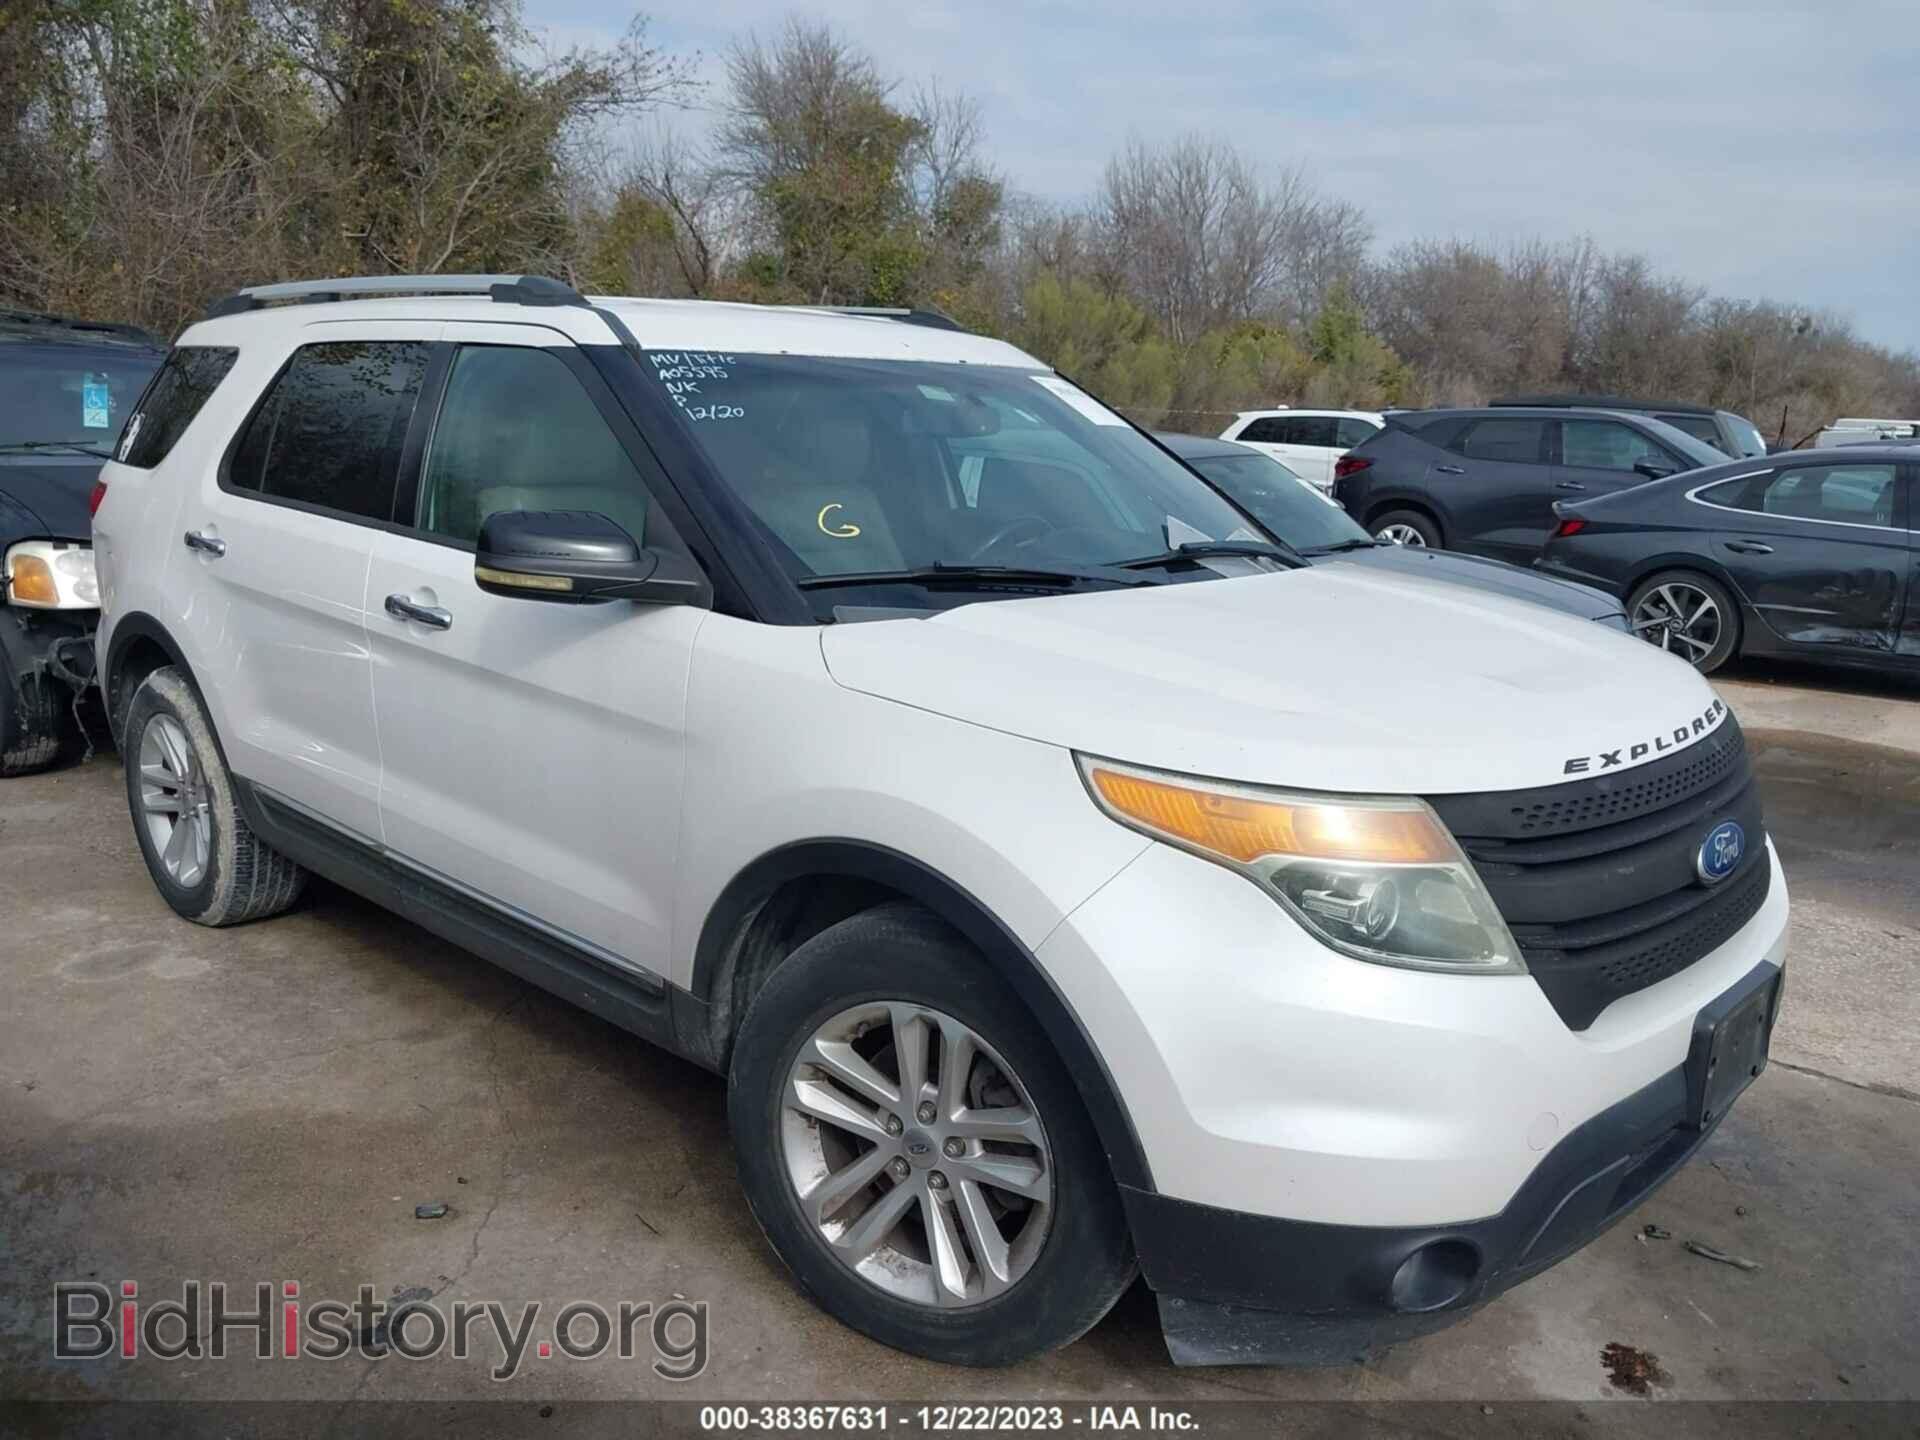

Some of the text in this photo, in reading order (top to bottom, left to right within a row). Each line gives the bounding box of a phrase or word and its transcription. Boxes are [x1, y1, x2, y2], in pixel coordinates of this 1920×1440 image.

[818, 503, 861, 537] G
[1563, 699, 1724, 775] EXPLORER
[1713, 831, 1740, 869] Ford
